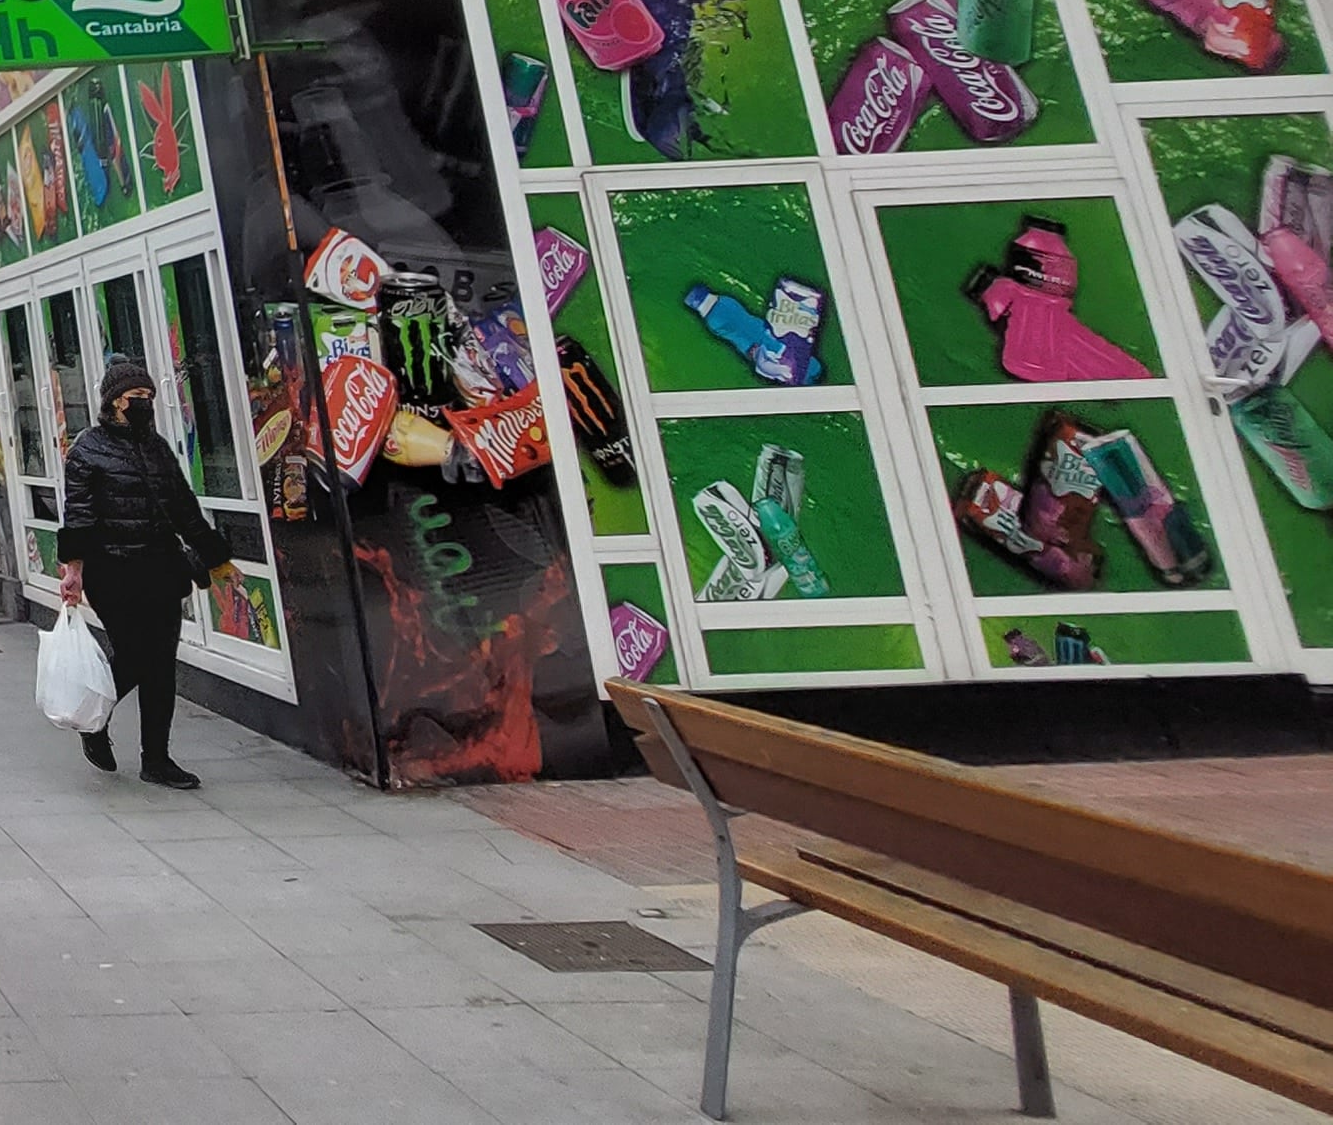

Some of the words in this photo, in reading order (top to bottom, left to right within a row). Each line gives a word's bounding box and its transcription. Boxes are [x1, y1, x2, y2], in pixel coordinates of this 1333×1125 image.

[85, 17, 183, 36] Cantabria
[332, 338, 349, 357] Bi
[727, 510, 758, 548] zero
